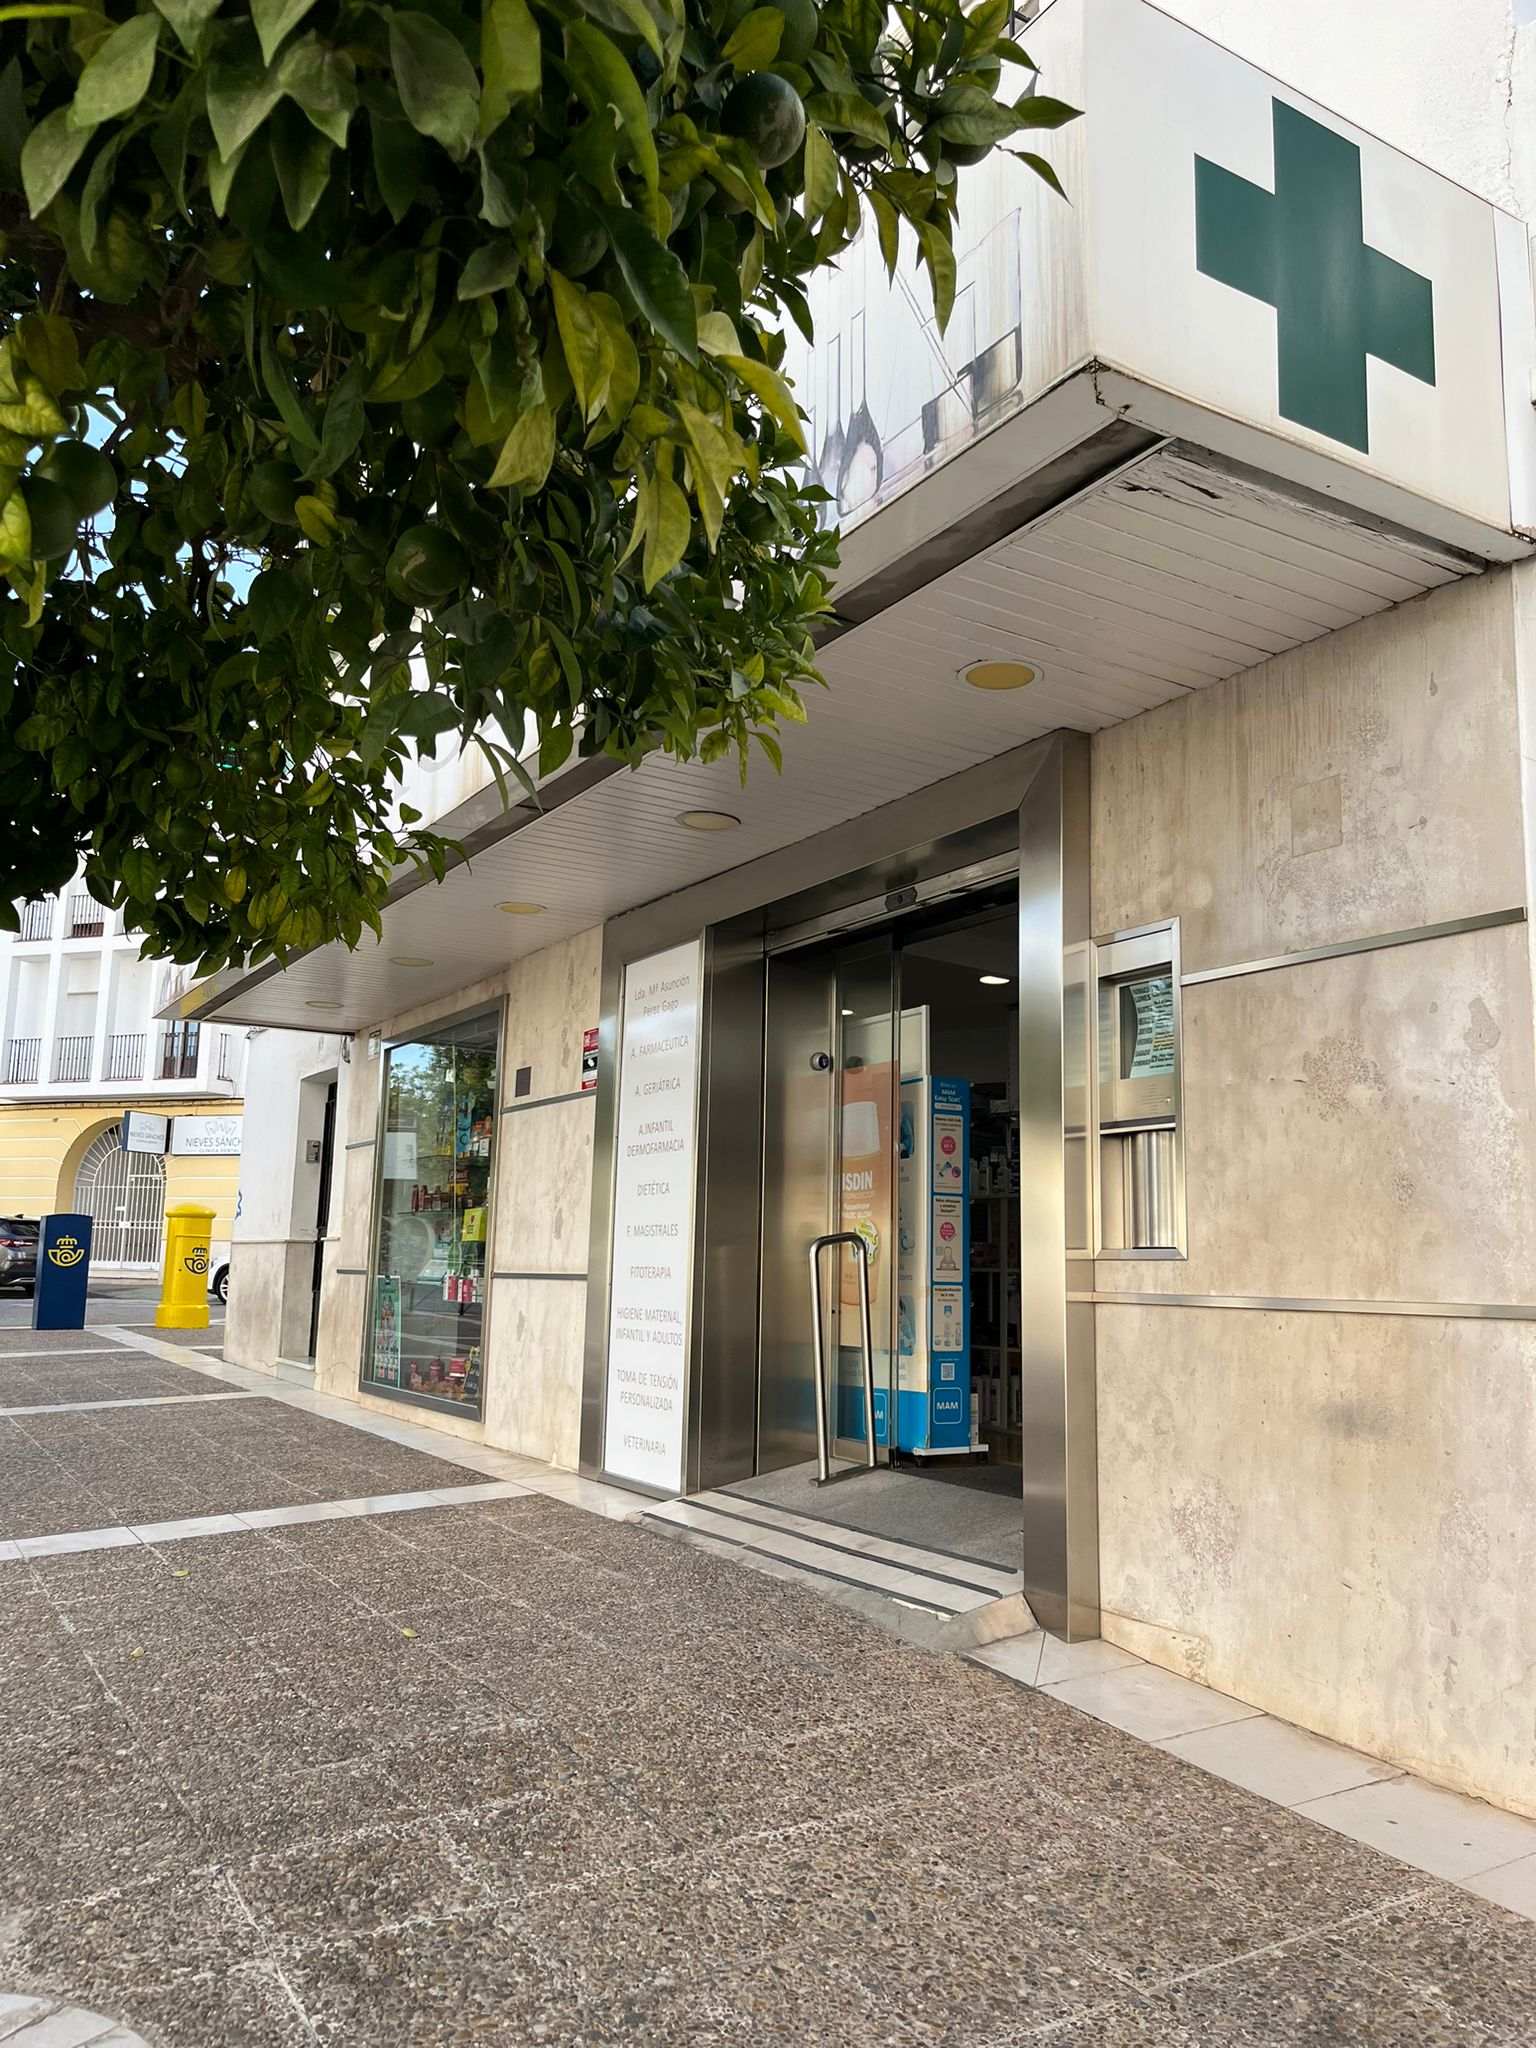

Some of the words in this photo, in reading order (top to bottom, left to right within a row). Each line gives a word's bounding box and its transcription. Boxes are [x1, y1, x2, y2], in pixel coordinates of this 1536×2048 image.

[634, 988, 647, 1001] Lda.
[660, 975, 690, 993] Asunción
[643, 1003, 660, 1017] Pérez
[661, 1000, 679, 1013] Gago
[630, 1047, 637, 1059] A.
[639, 1034, 689, 1056] FARMACÉUTICA
[634, 1085, 641, 1097] A.
[643, 1077, 681, 1096] GERIÁTRICA
[185, 1137, 213, 1147] NIEVES
[627, 1139, 684, 1157] DERMOFARMACIA
[637, 1181, 670, 1196] DIETÉTICA
[842, 1170, 873, 1190] ISDIN
[633, 1223, 679, 1237] MAGISTRALES
[630, 1266, 672, 1279] FITOTERAPIA
[617, 1307, 642, 1321] HIGIENE
[616, 1328, 644, 1342] INFANTIL
[646, 1330, 651, 1343] Y
[652, 1331, 683, 1346] ADULTOS
[617, 1369, 636, 1383] TOMA
[639, 1372, 647, 1385] DE
[650, 1373, 678, 1390] TENSIÓN
[620, 1390, 672, 1412] PERSONALIZADA
[936, 1401, 959, 1410] MAM
[623, 1433, 666, 1455] VETERINARIA
